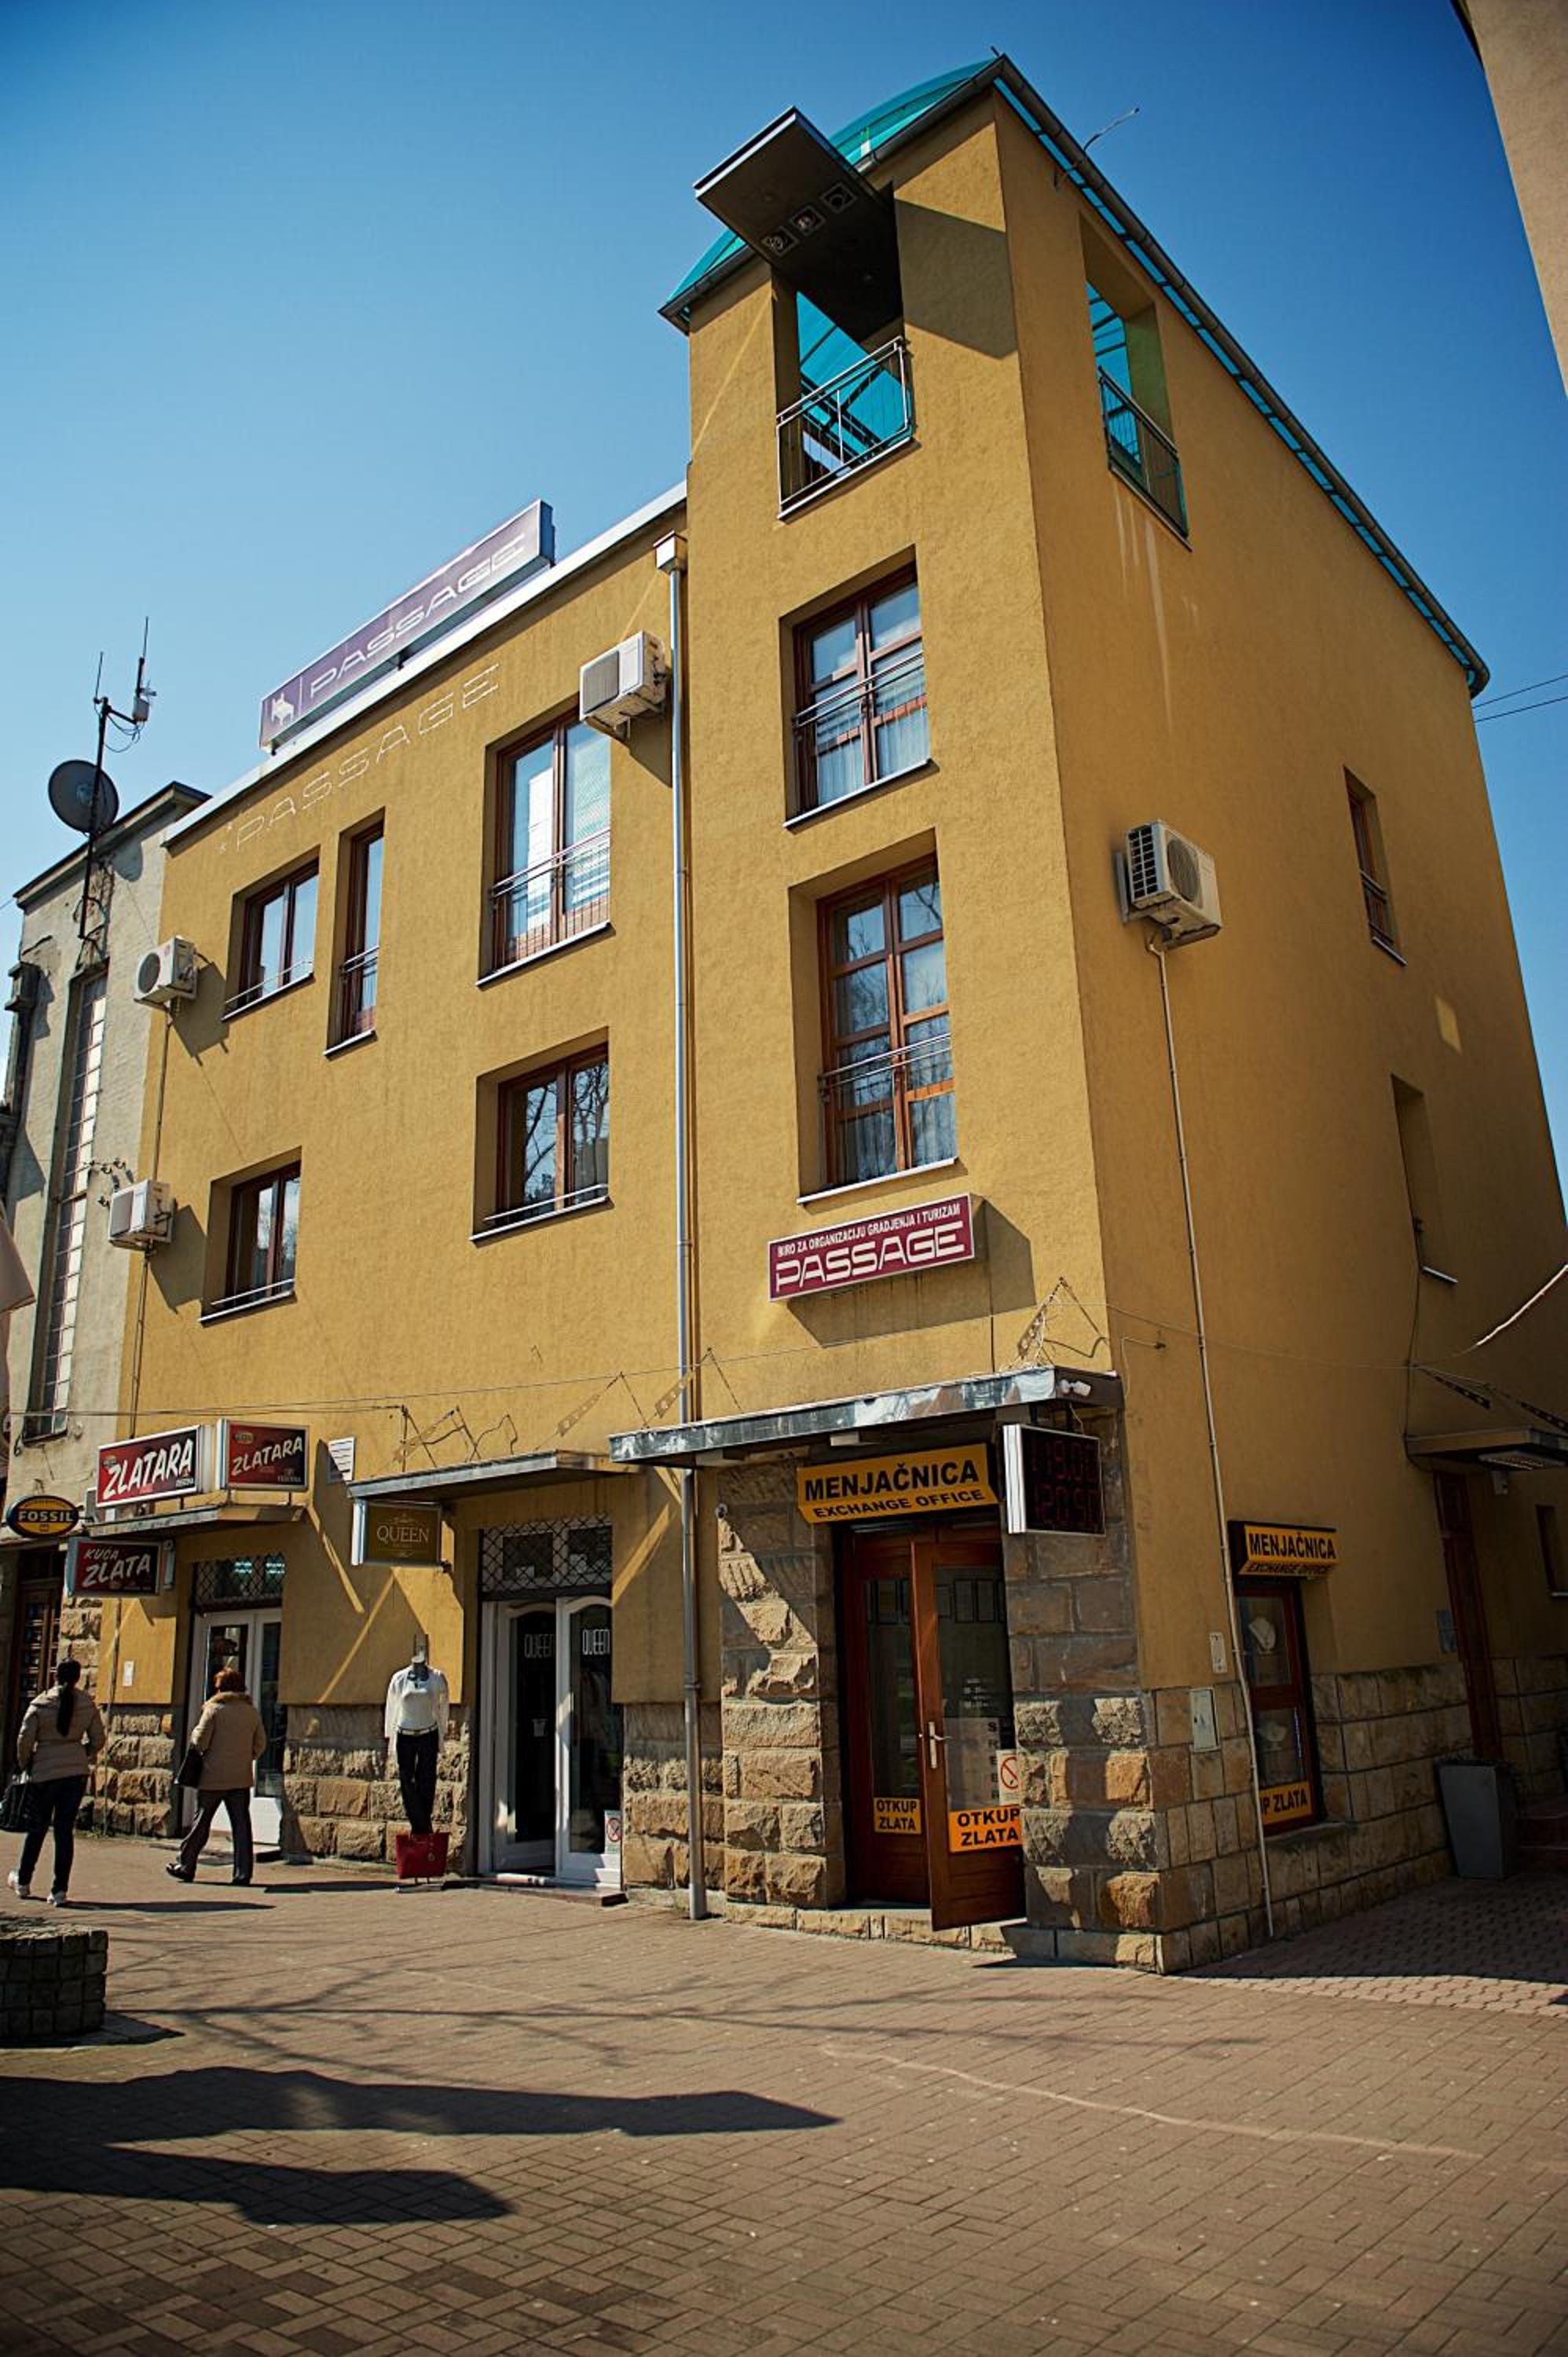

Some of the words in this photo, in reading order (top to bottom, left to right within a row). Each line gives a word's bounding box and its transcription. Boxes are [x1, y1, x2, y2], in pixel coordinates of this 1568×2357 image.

[310, 533, 525, 698] PASSAGE
[237, 664, 499, 850] PASSAGE
[778, 1244, 795, 1257] BIRO
[797, 1242, 807, 1254] ZA
[809, 1226, 866, 1249] ORGANIZACIJU
[867, 1215, 916, 1235] GRADJENJA
[922, 1203, 961, 1222] TURIZAM
[776, 1220, 965, 1292] PASSAGE
[104, 1439, 193, 1499] ZLATARA
[232, 1436, 303, 1476] ZLATARA
[805, 1460, 979, 1501] MENJAČNICA
[19, 1510, 74, 1522] FOSSIL
[813, 1497, 911, 1518] EXCHANGE
[918, 1489, 985, 1508] OFFICE
[377, 1525, 428, 1544] QUEEN
[1248, 1531, 1336, 1560] MENJAČNICA
[82, 1554, 151, 1587] ZLATA
[877, 1800, 917, 1813] OTKUP
[1273, 1787, 1307, 1813] ZLATA
[879, 1816, 916, 1831] ZLATA
[957, 1808, 1020, 1827] OTKUP
[961, 1827, 1019, 1846] ZLATA
